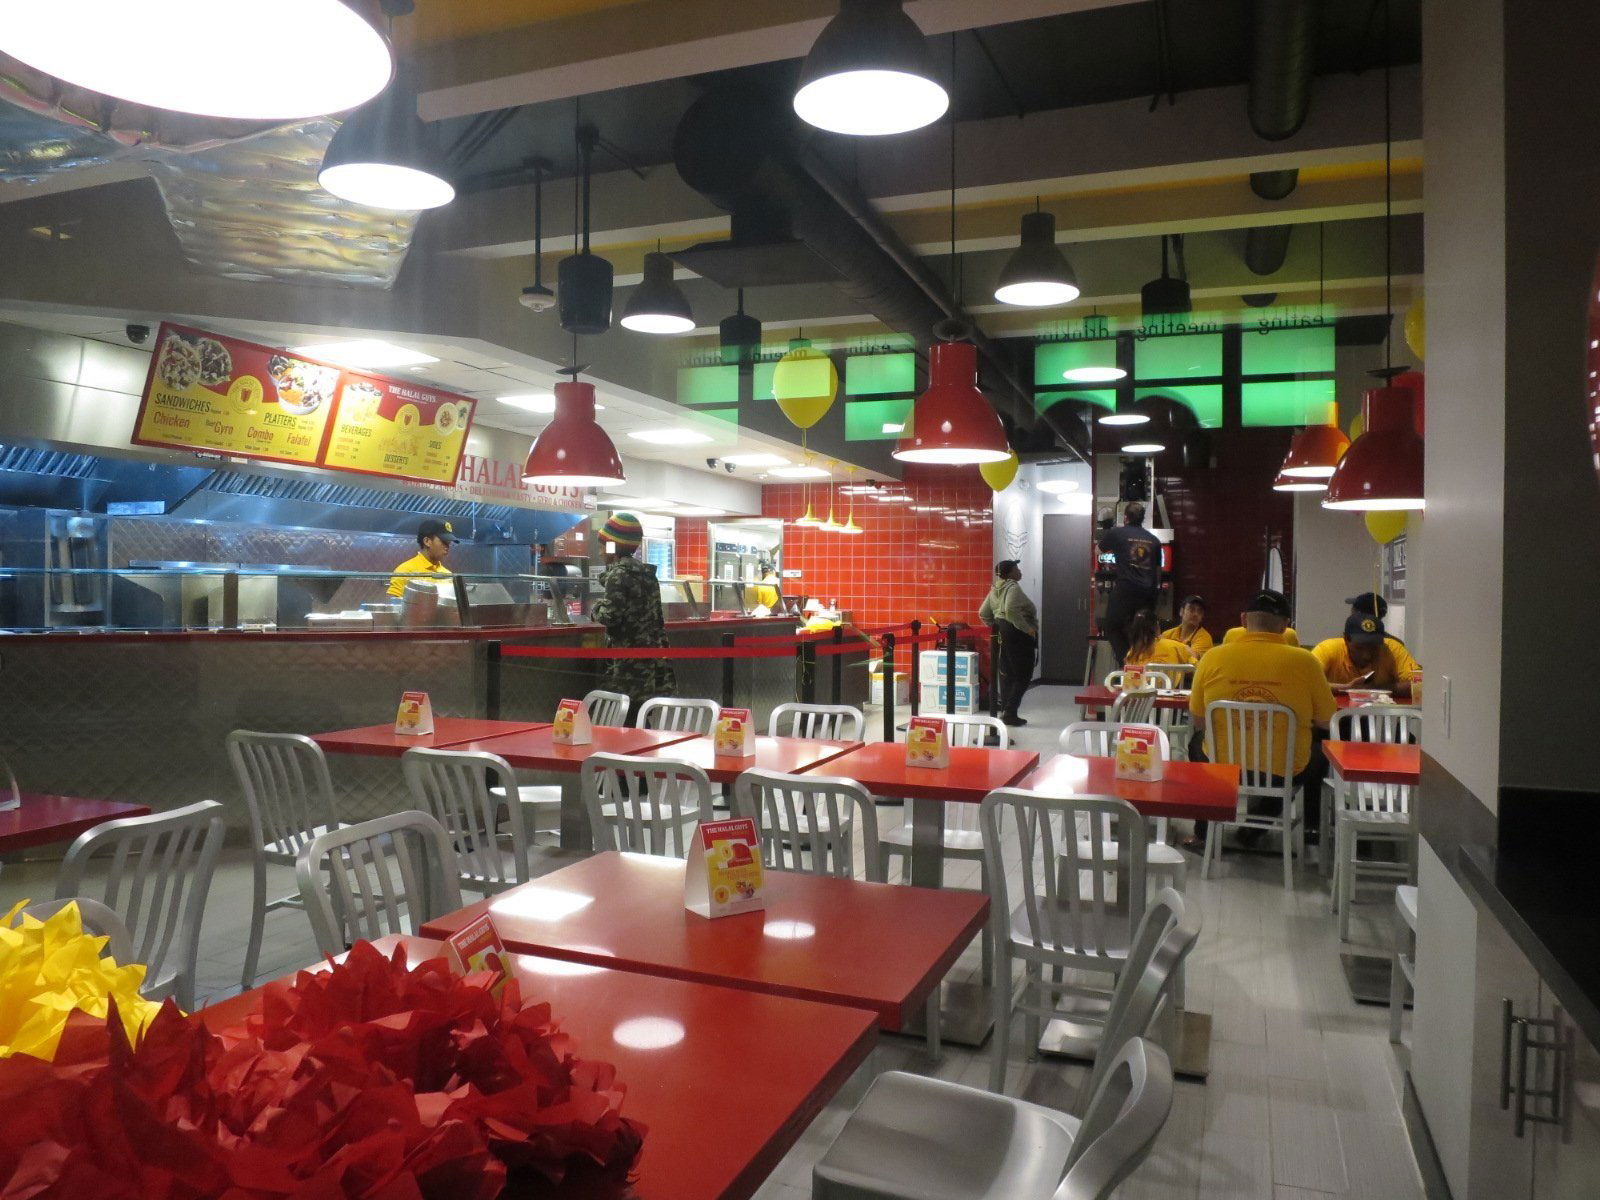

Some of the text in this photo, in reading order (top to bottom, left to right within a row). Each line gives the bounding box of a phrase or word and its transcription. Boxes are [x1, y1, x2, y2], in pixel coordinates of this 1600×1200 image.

[388, 385, 401, 394] THE
[401, 389, 420, 400] HALAL
[154, 392, 212, 413] SANDWICHES
[153, 411, 190, 429] Chicken
[263, 412, 297, 428] PLATTERS
[214, 421, 234, 436] Gyro
[247, 426, 274, 441] Combo
[340, 425, 372, 437] BEVERAGES
[286, 432, 312, 447] Falafel
[460, 454, 528, 491] HALAL
